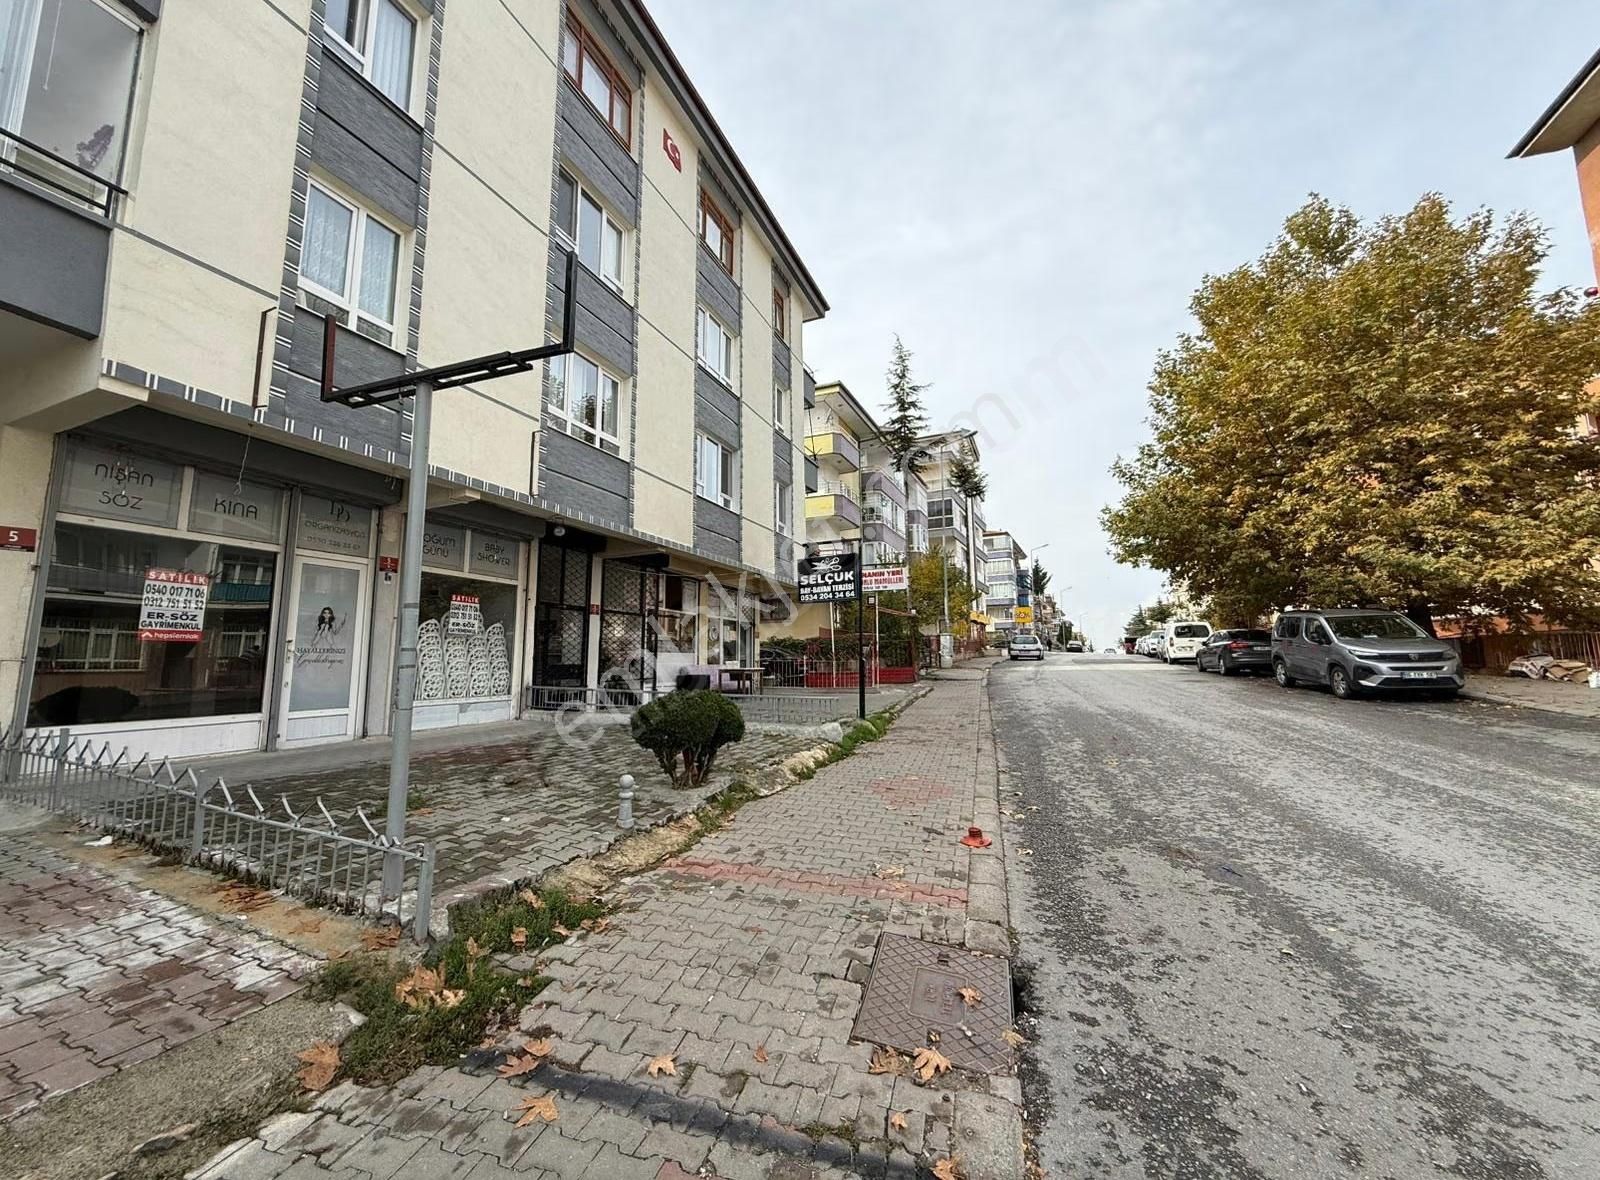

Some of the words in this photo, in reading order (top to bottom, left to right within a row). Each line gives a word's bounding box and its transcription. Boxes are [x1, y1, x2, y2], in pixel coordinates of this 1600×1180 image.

[213, 497, 259, 521] KINA
[8, 530, 19, 542] 5
[423, 533, 456, 547] OĞUM
[149, 571, 206, 585] SATILIK
[800, 571, 854, 586] SELÇUK
[145, 583, 168, 596] 0540
[169, 586, 184, 597] 017
[185, 587, 194, 598] 71
[195, 588, 206, 599] 06
[819, 592, 833, 600] 204
[834, 591, 844, 599] 34
[845, 590, 856, 598] 64
[144, 596, 164, 608] 0312
[166, 597, 180, 609] 751
[183, 599, 192, 610] 51
[194, 600, 205, 611] 52
[147, 611, 199, 622] ER-SÖZ
[140, 619, 201, 631] GAYRİMENKUL
